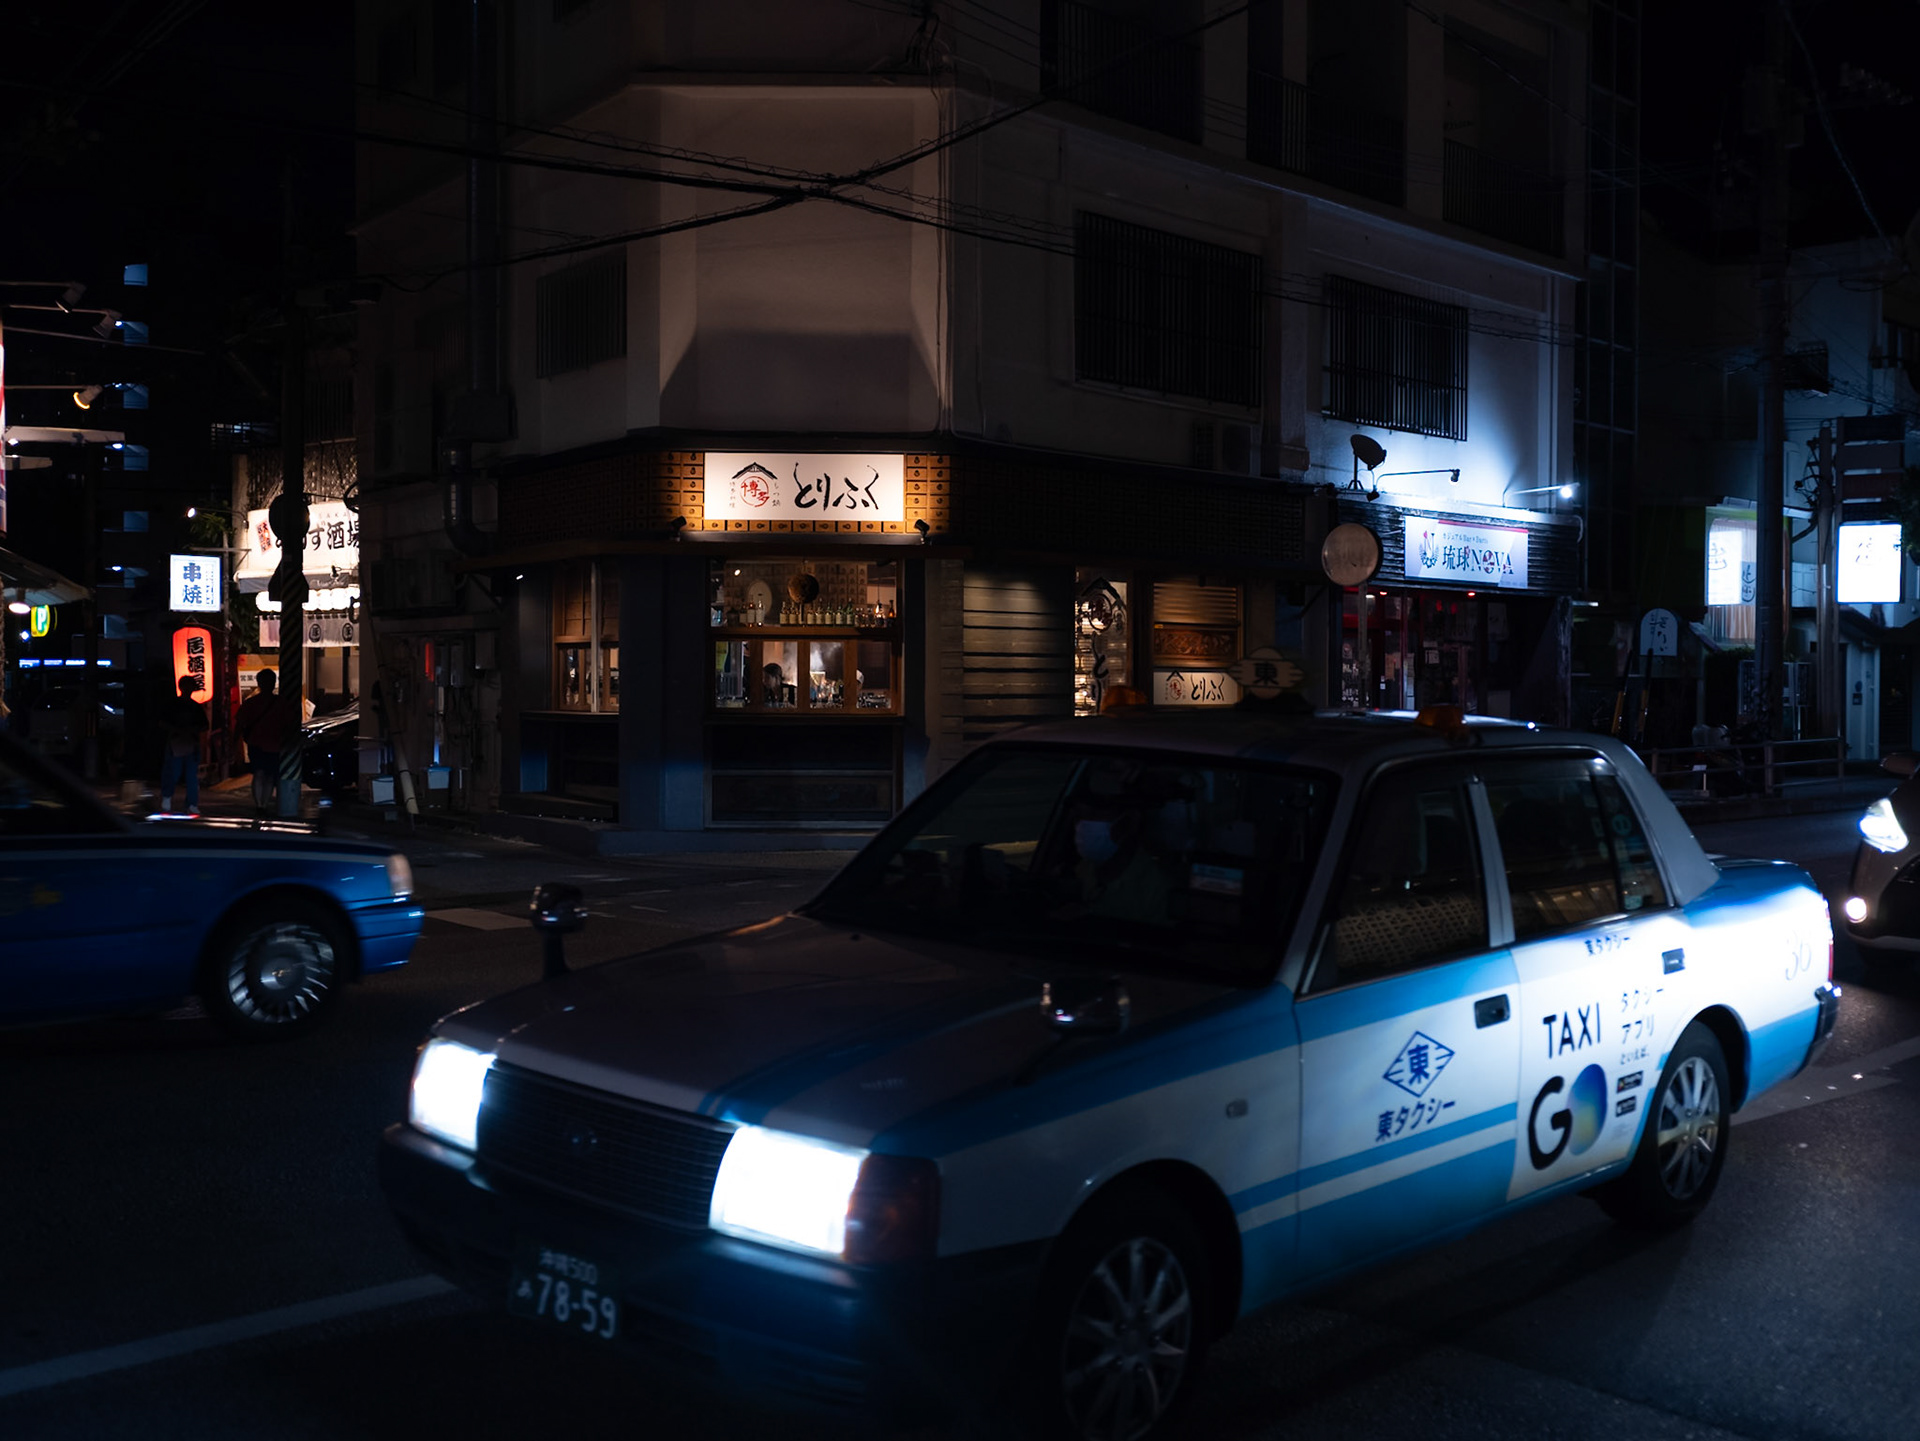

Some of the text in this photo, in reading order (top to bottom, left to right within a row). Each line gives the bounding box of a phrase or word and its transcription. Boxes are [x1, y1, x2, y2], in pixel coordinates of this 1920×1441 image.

[793, 462, 879, 511] とりふく
[1442, 545, 1514, 574] 琉球NOVA
[183, 562, 202, 604] 串焼
[37, 607, 47, 631] P
[1190, 674, 1225, 702] とりふく
[1253, 662, 1279, 685] 東
[1542, 1002, 1602, 1060] TAXI
[1621, 1013, 1656, 1045] アプリ
[1407, 1044, 1430, 1086] 東
[1375, 1097, 1456, 1142] 東タクシー
[536, 1271, 617, 1341] 78-59
